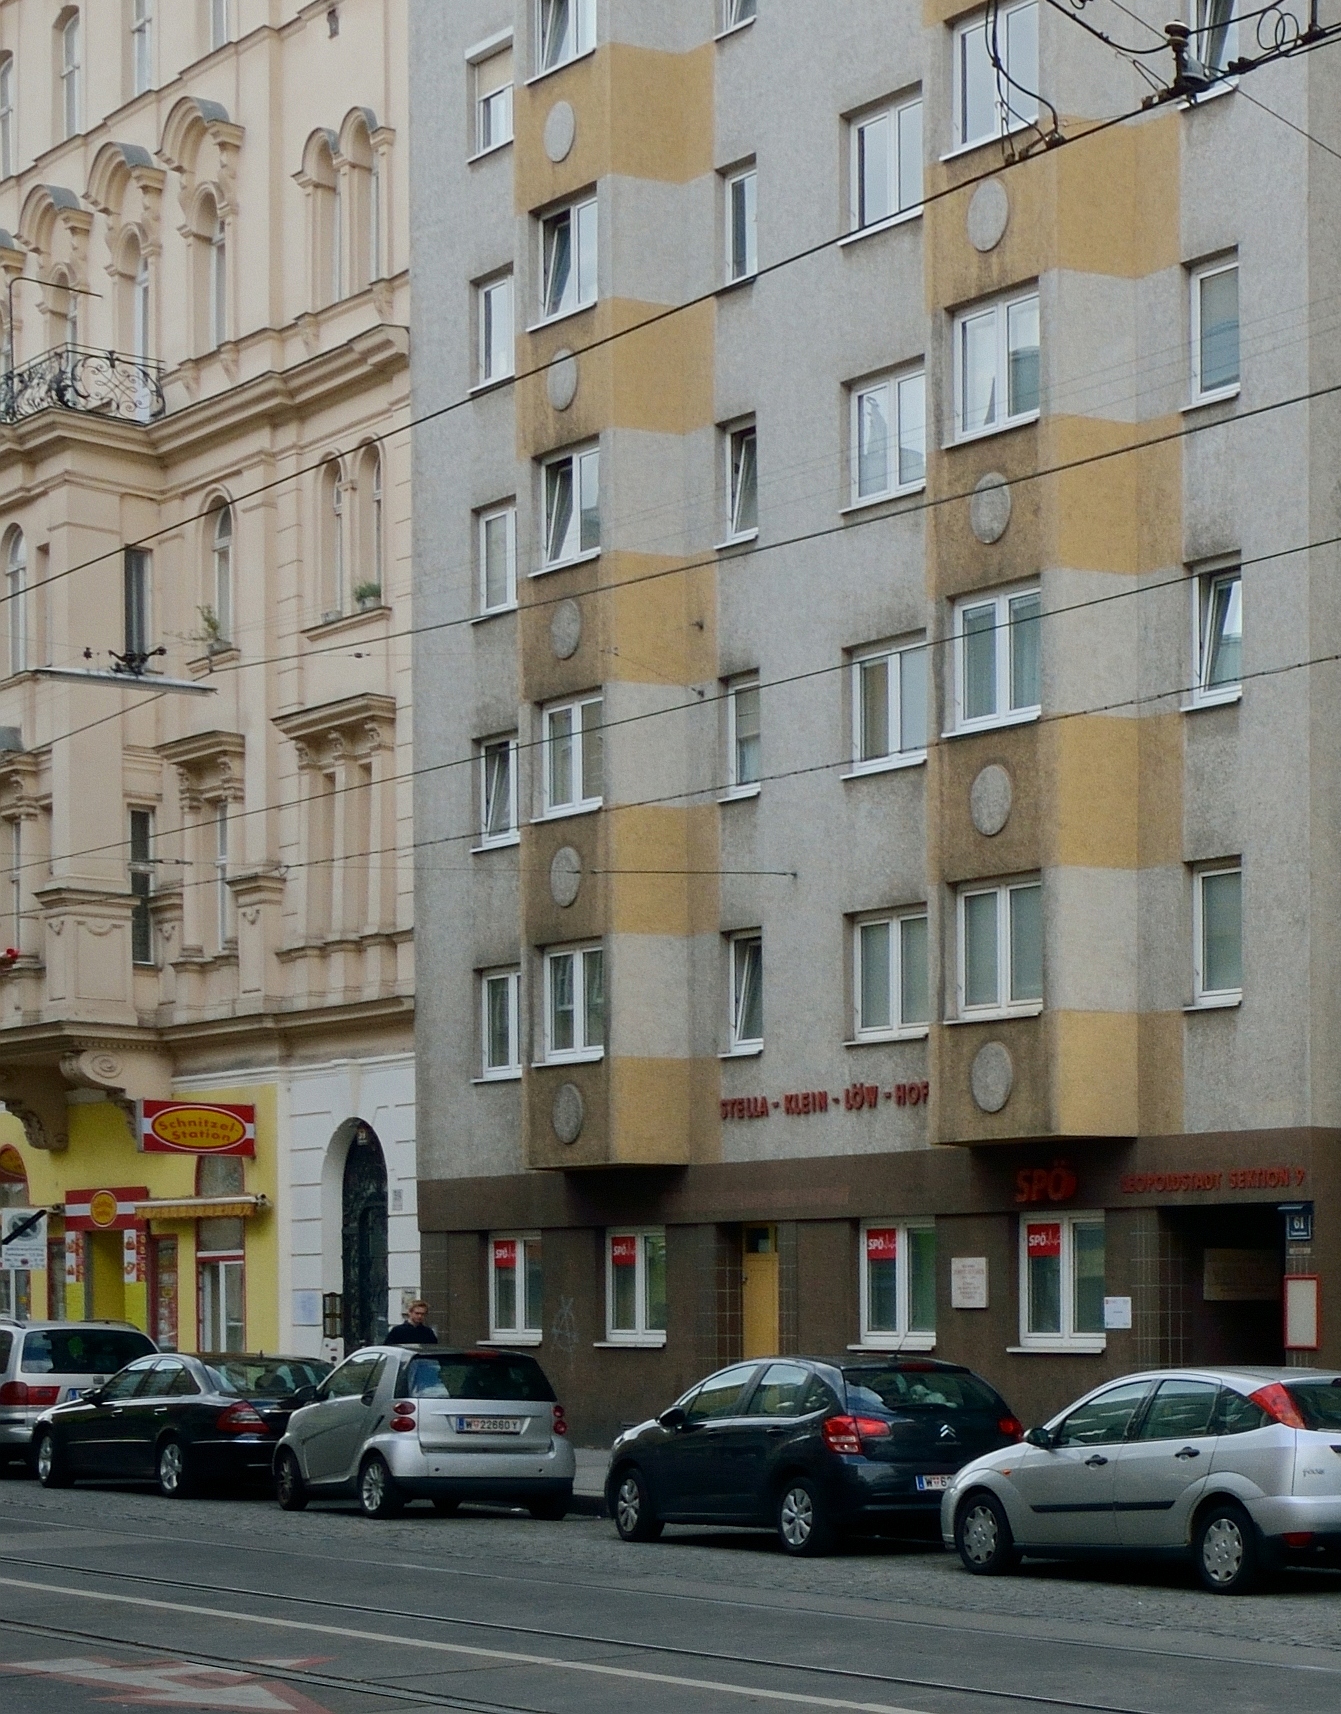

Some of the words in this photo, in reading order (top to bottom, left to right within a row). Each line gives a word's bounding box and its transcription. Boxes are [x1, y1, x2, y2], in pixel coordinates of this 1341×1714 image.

[721, 1096, 769, 1120] STELLA
[784, 1091, 828, 1115] KLEIN
[844, 1082, 879, 1111] LÖW
[895, 1081, 930, 1107] HOF
[172, 1129, 231, 1142] Station
[1293, 1216, 1304, 1229] 61
[868, 1236, 884, 1250] SPÖ
[1028, 1231, 1046, 1247] SPÖ
